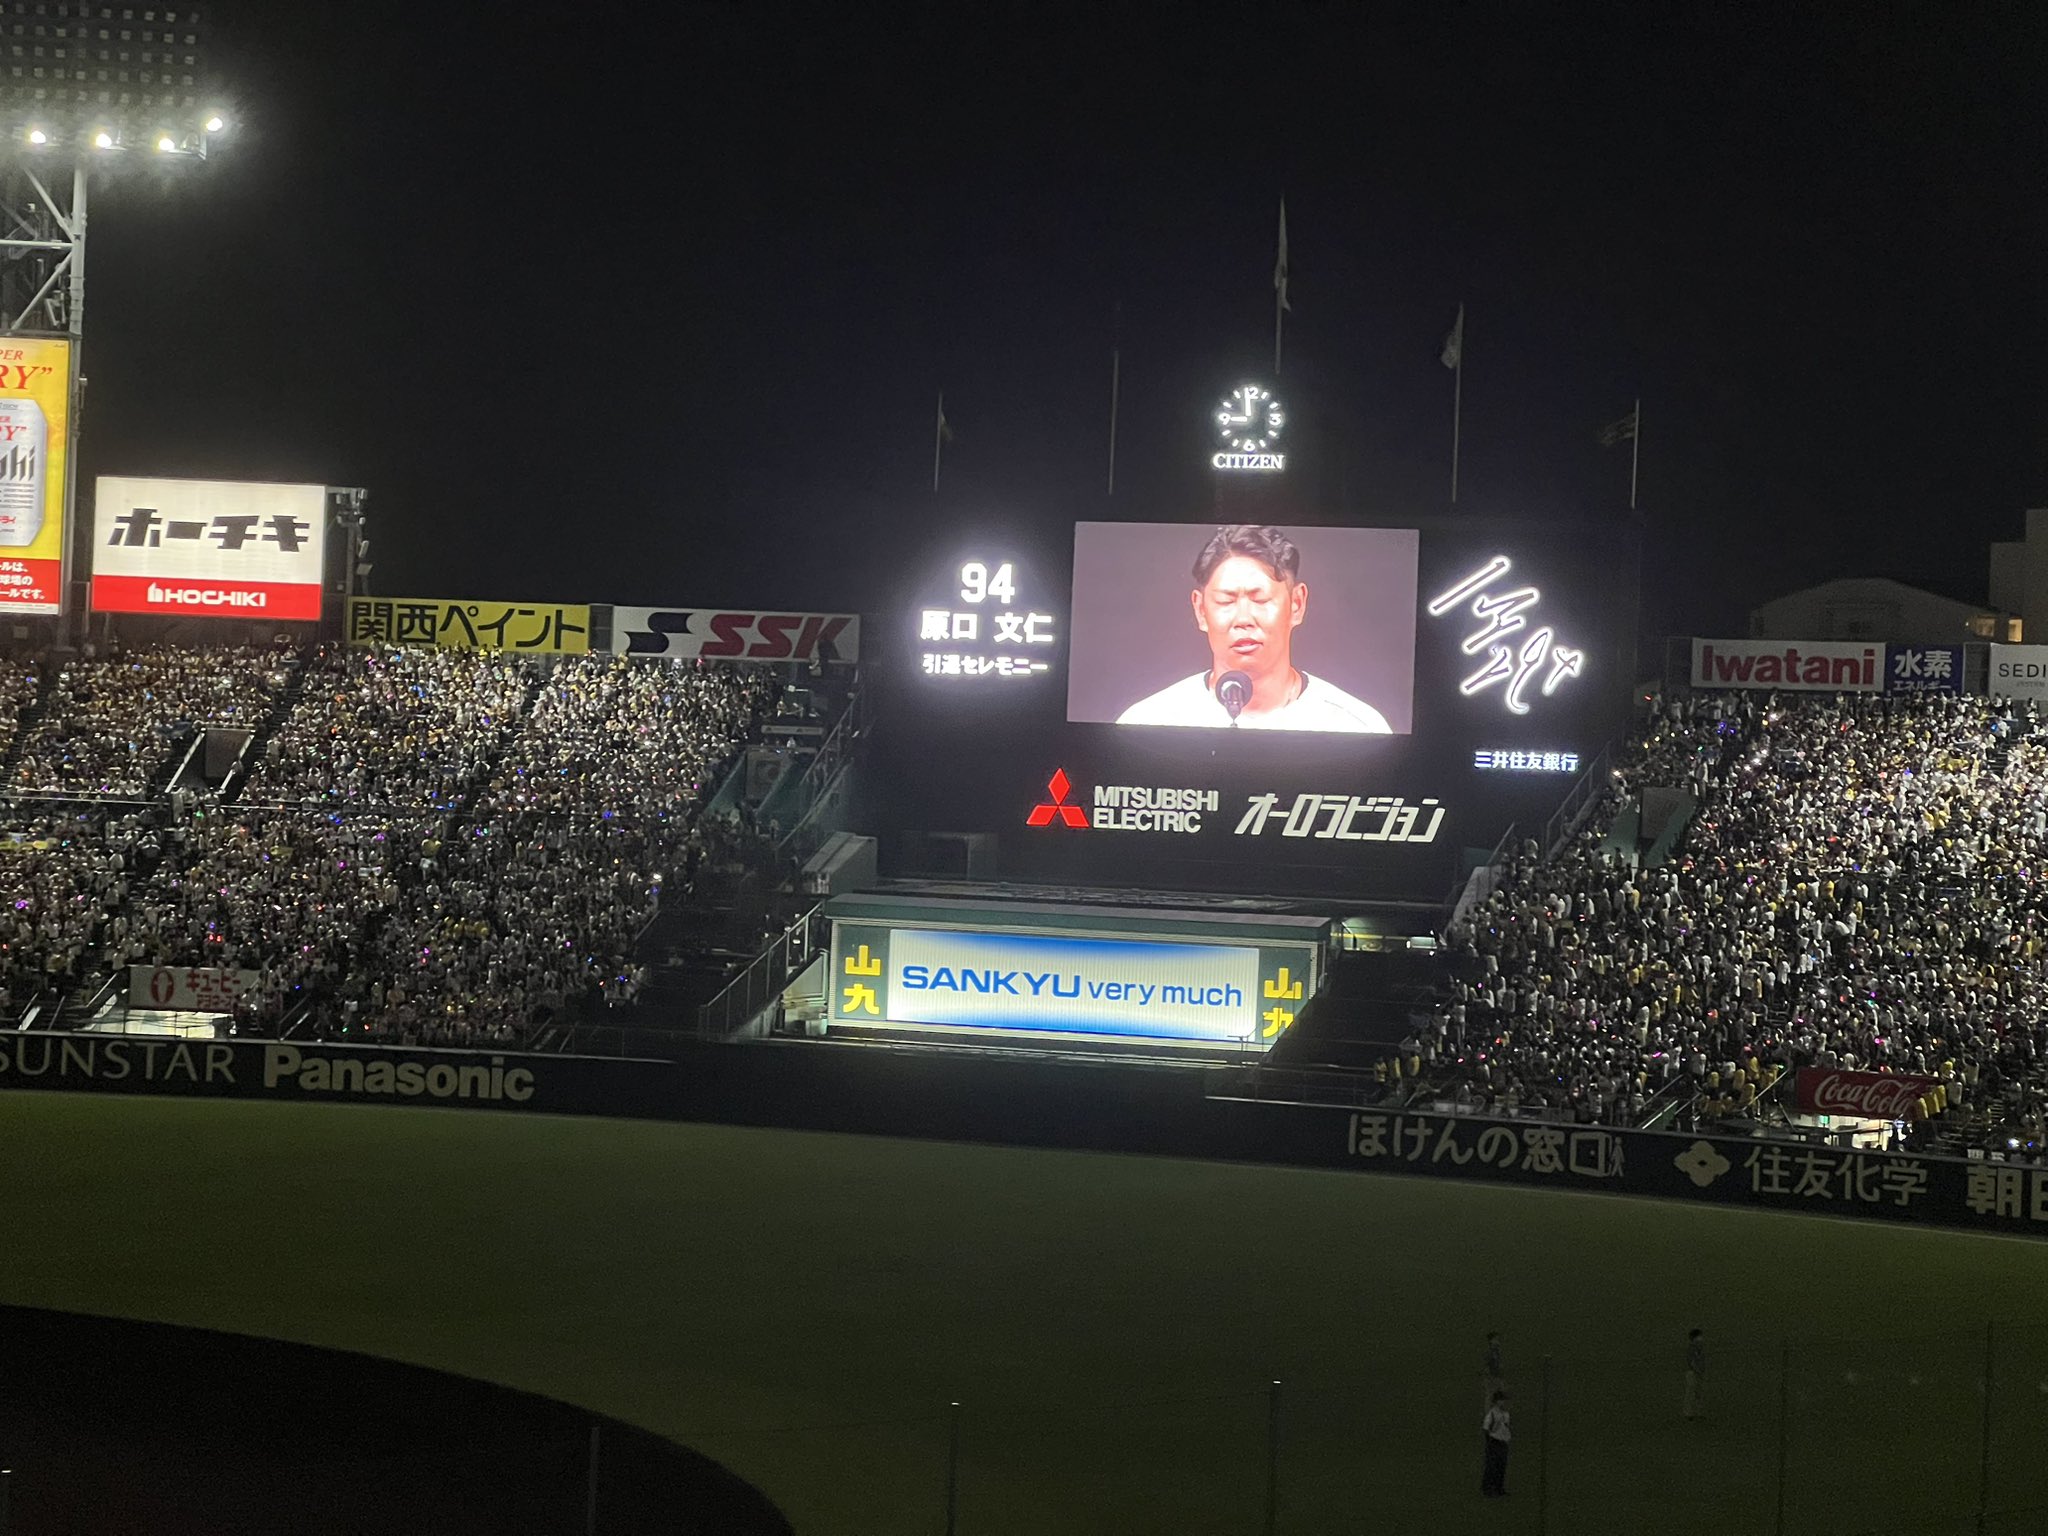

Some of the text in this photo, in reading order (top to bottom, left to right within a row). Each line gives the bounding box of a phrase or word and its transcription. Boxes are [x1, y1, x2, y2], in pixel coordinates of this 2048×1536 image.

[1219, 413, 1231, 425] 9
[1269, 414, 1281, 426] 3
[1212, 453, 1285, 469] CITIZEN
[1243, 440, 1256, 451] 6
[107, 507, 310, 553] ホーチキ
[165, 588, 266, 607] HOCHIKI
[960, 562, 1016, 604] 94
[351, 601, 586, 650] 関西ペイント
[701, 613, 854, 660] SSK
[920, 610, 1054, 643] 原口 文仁
[1702, 645, 1875, 685] Iwatani
[1894, 649, 1953, 679] 水素
[1474, 751, 1579, 771] 三井住友銀行
[1094, 785, 1219, 812] MITSUBISHI
[1093, 807, 1201, 834] ELECTRIC
[186, 969, 241, 993] キューピー
[843, 945, 881, 1015] 山九
[902, 966, 1242, 1007] SANKYU very much
[264, 1046, 535, 1101] Panasonic
[1744, 1146, 1928, 1206] 住友化学
